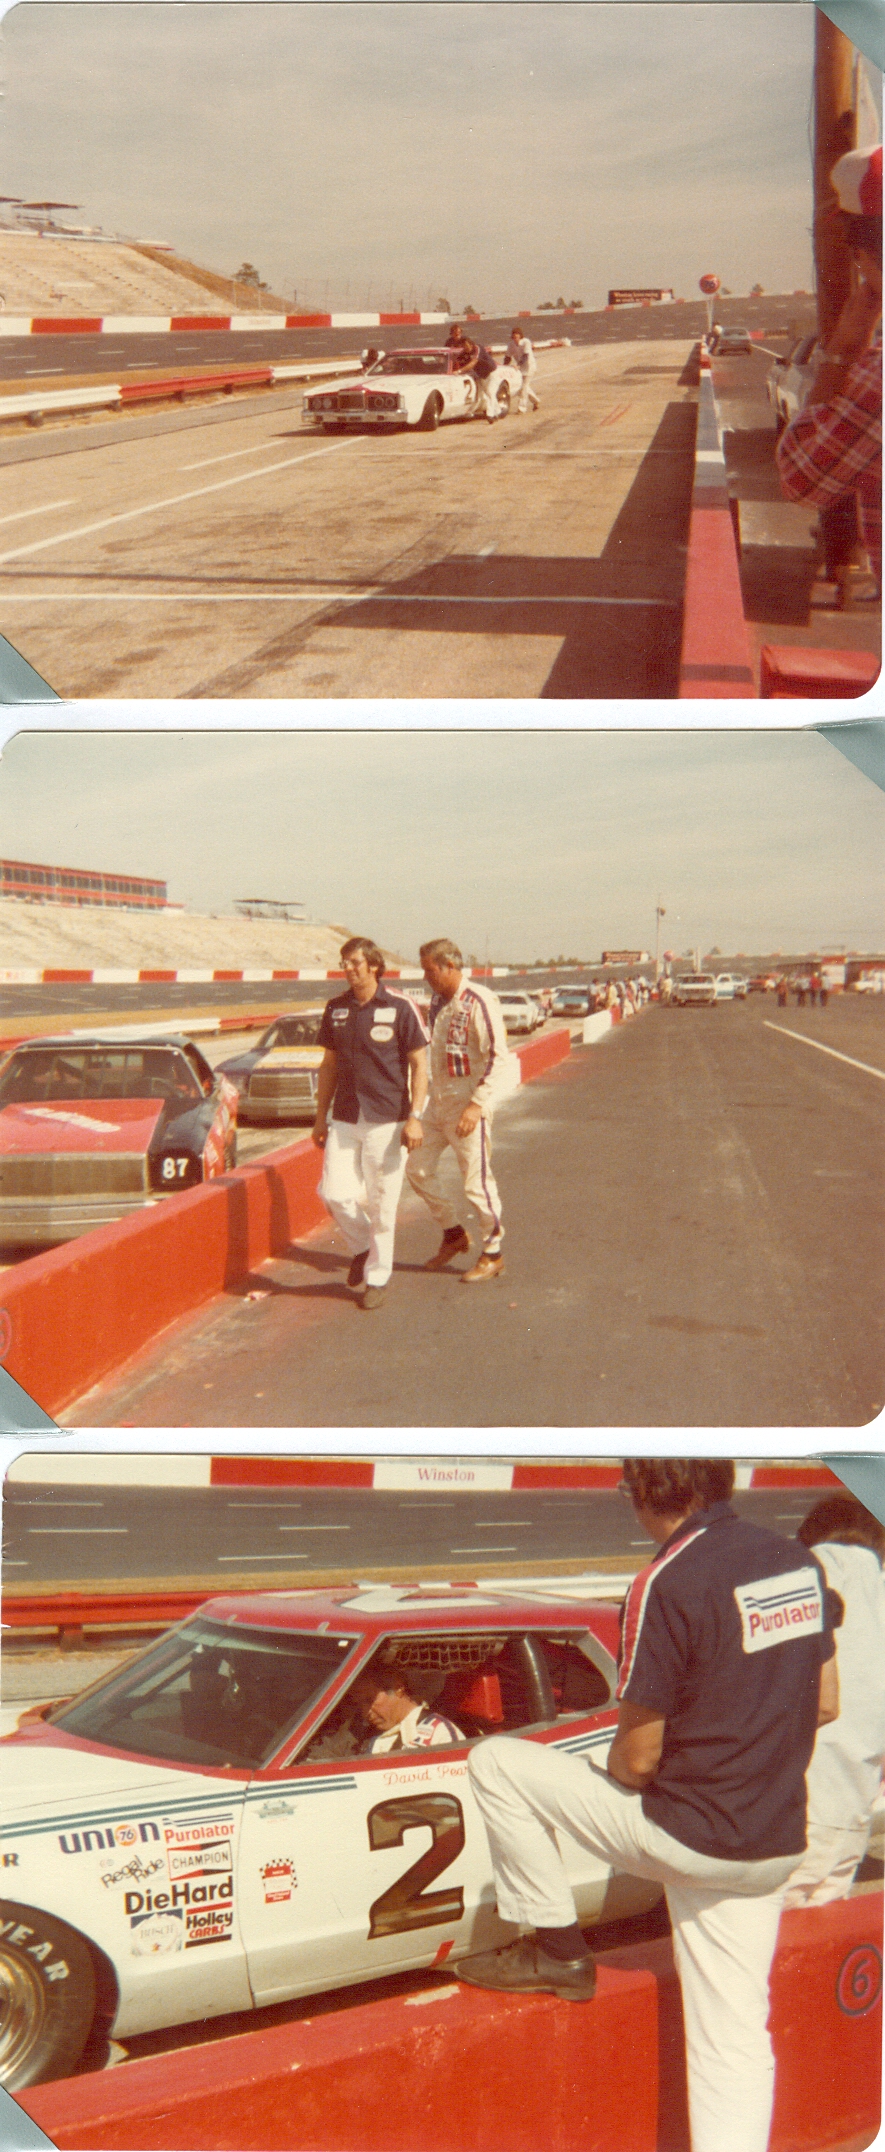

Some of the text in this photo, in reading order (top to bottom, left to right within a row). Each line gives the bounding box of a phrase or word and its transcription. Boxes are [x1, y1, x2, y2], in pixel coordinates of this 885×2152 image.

[162, 1157, 189, 1179] 87
[417, 1468, 475, 1481] Winston
[748, 1602, 820, 1638] Purolator
[383, 1768, 432, 1786] David
[119, 1829, 134, 1842] 76
[164, 1823, 235, 1844] Purolator
[171, 1851, 229, 1869] CHAMPION
[367, 1792, 466, 1941] 2
[101, 1854, 143, 1888] Regal
[124, 1875, 233, 1915] DieHard
[186, 1911, 233, 1930] Holley
[189, 1924, 225, 1939] CARBS
[852, 1959, 869, 1998] 6
